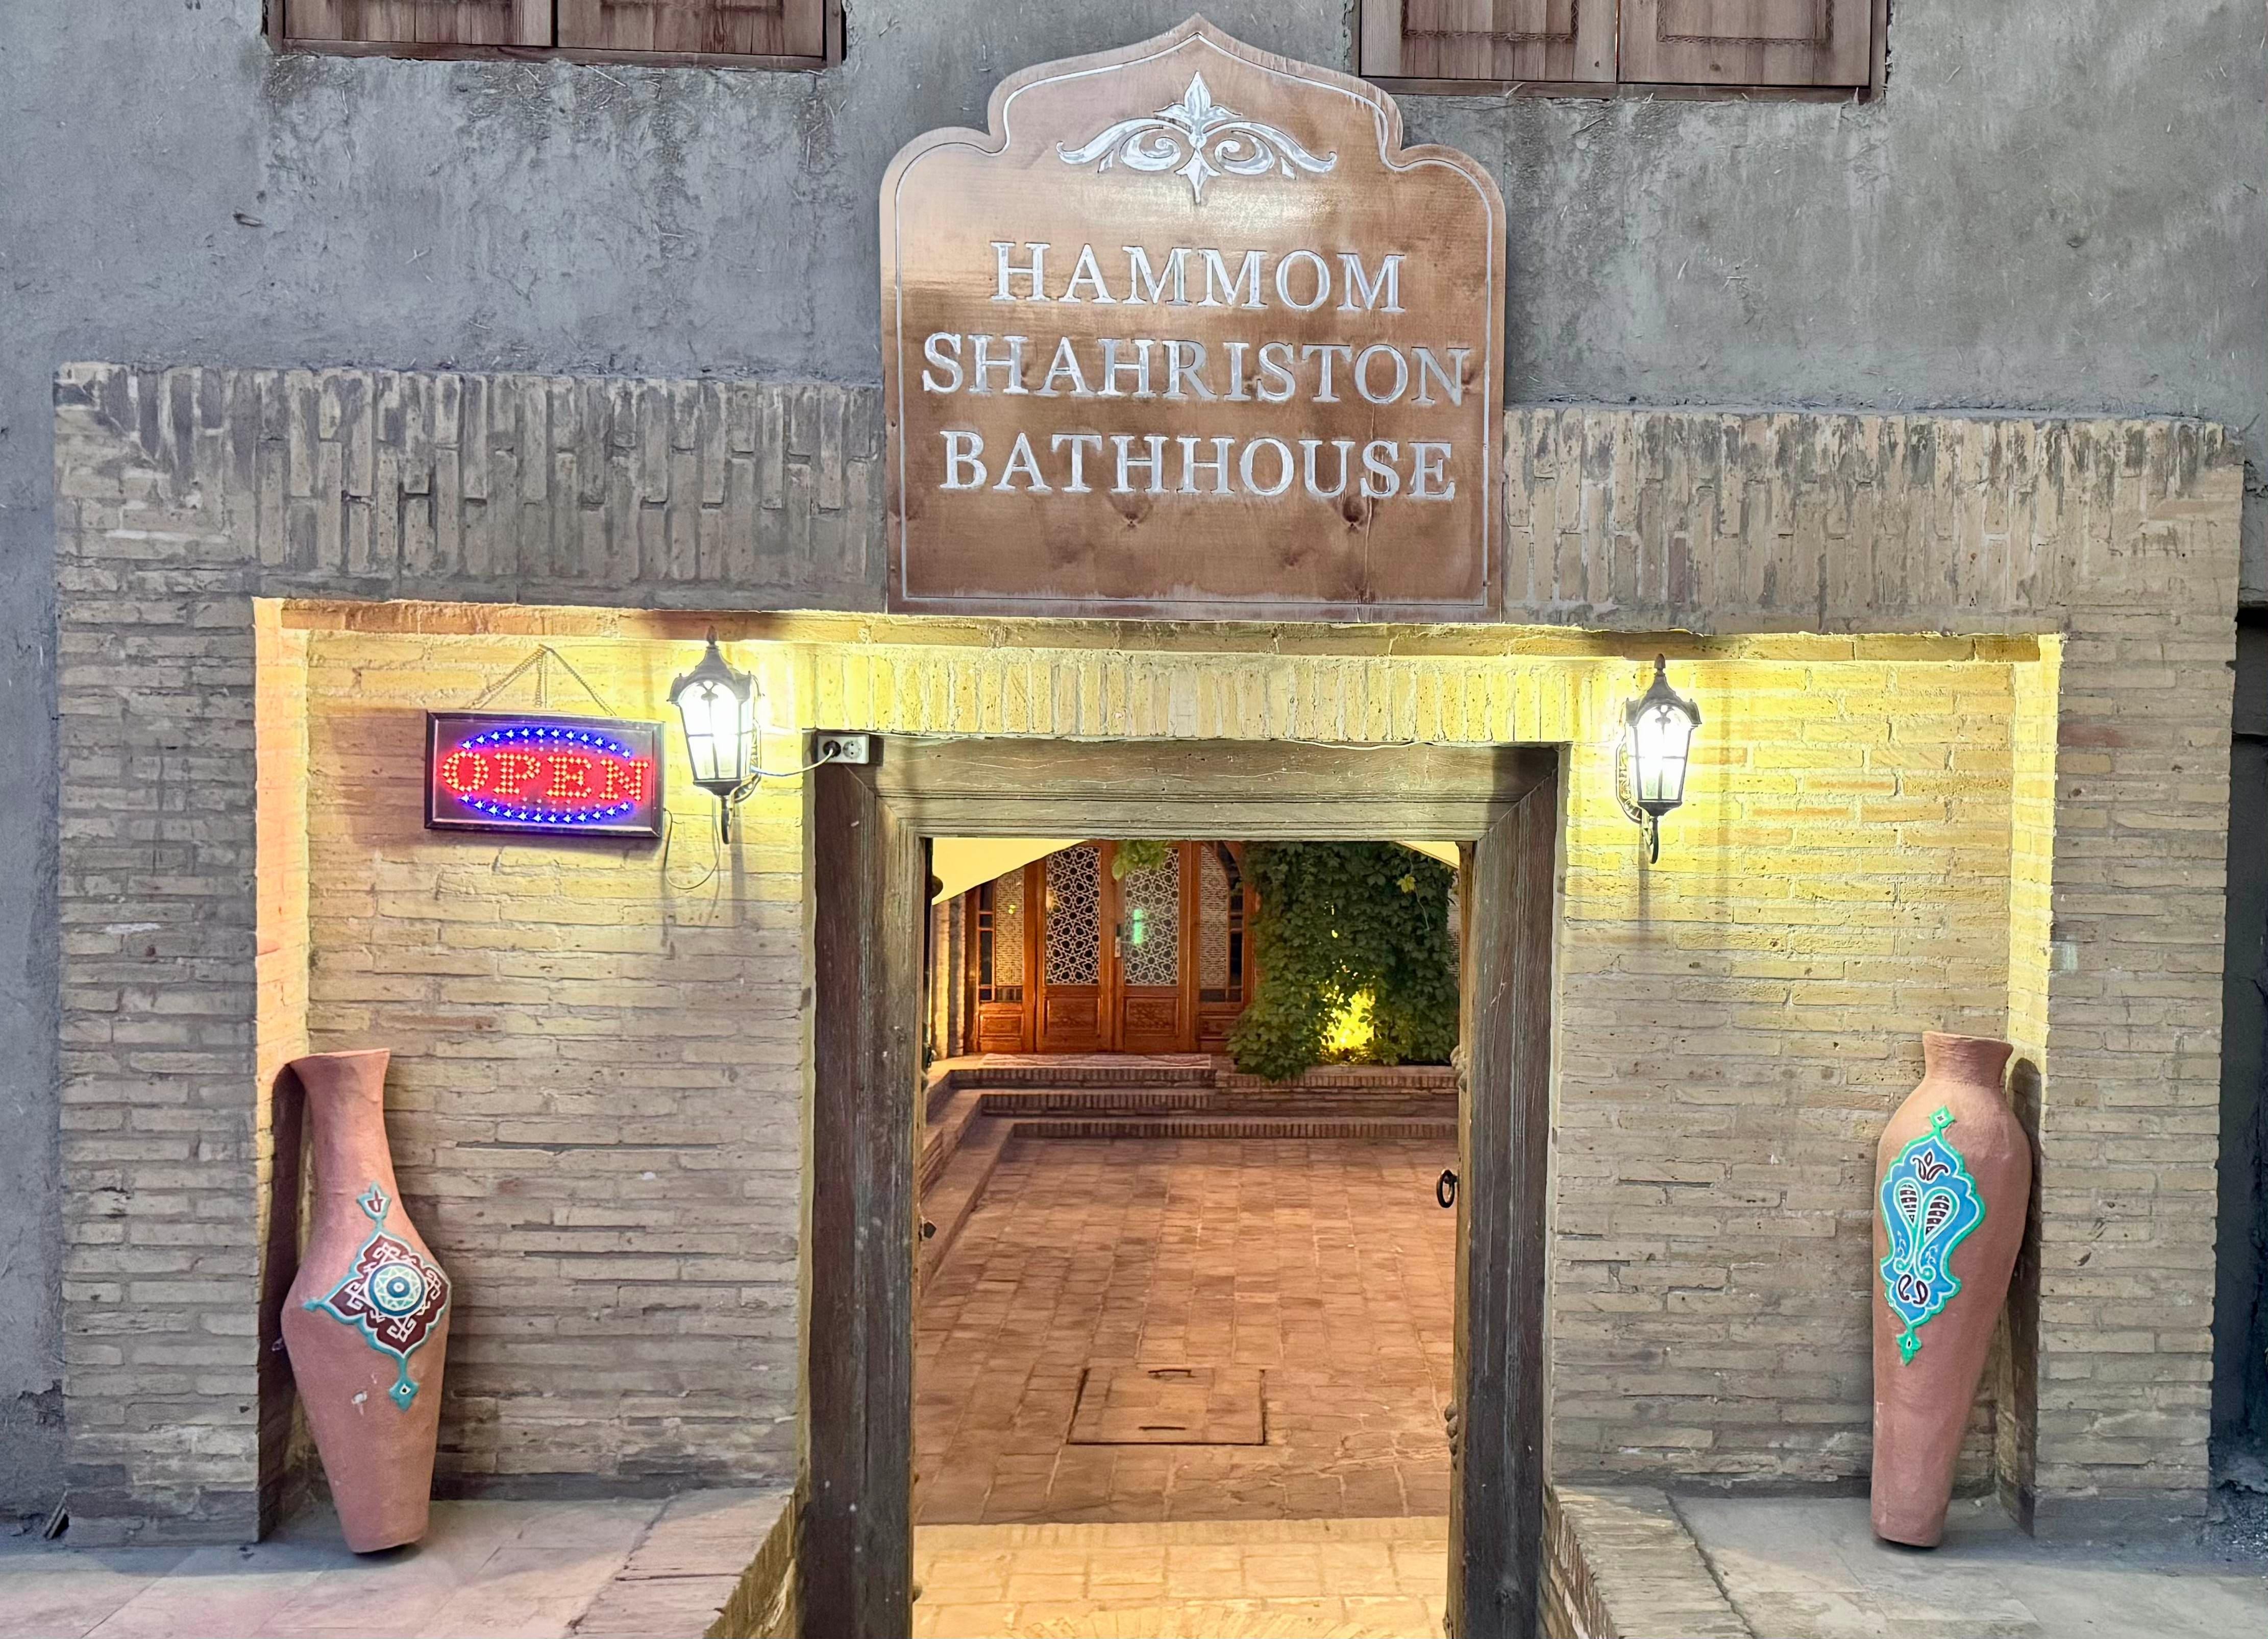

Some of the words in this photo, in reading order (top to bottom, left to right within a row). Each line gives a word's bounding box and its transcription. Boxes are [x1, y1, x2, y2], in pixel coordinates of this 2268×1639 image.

[990, 240, 1407, 312] HAMMOM
[922, 332, 1471, 406] SHAHRISTON
[939, 430, 1456, 501] BATHHOUSE
[442, 749, 650, 801] OPEN
